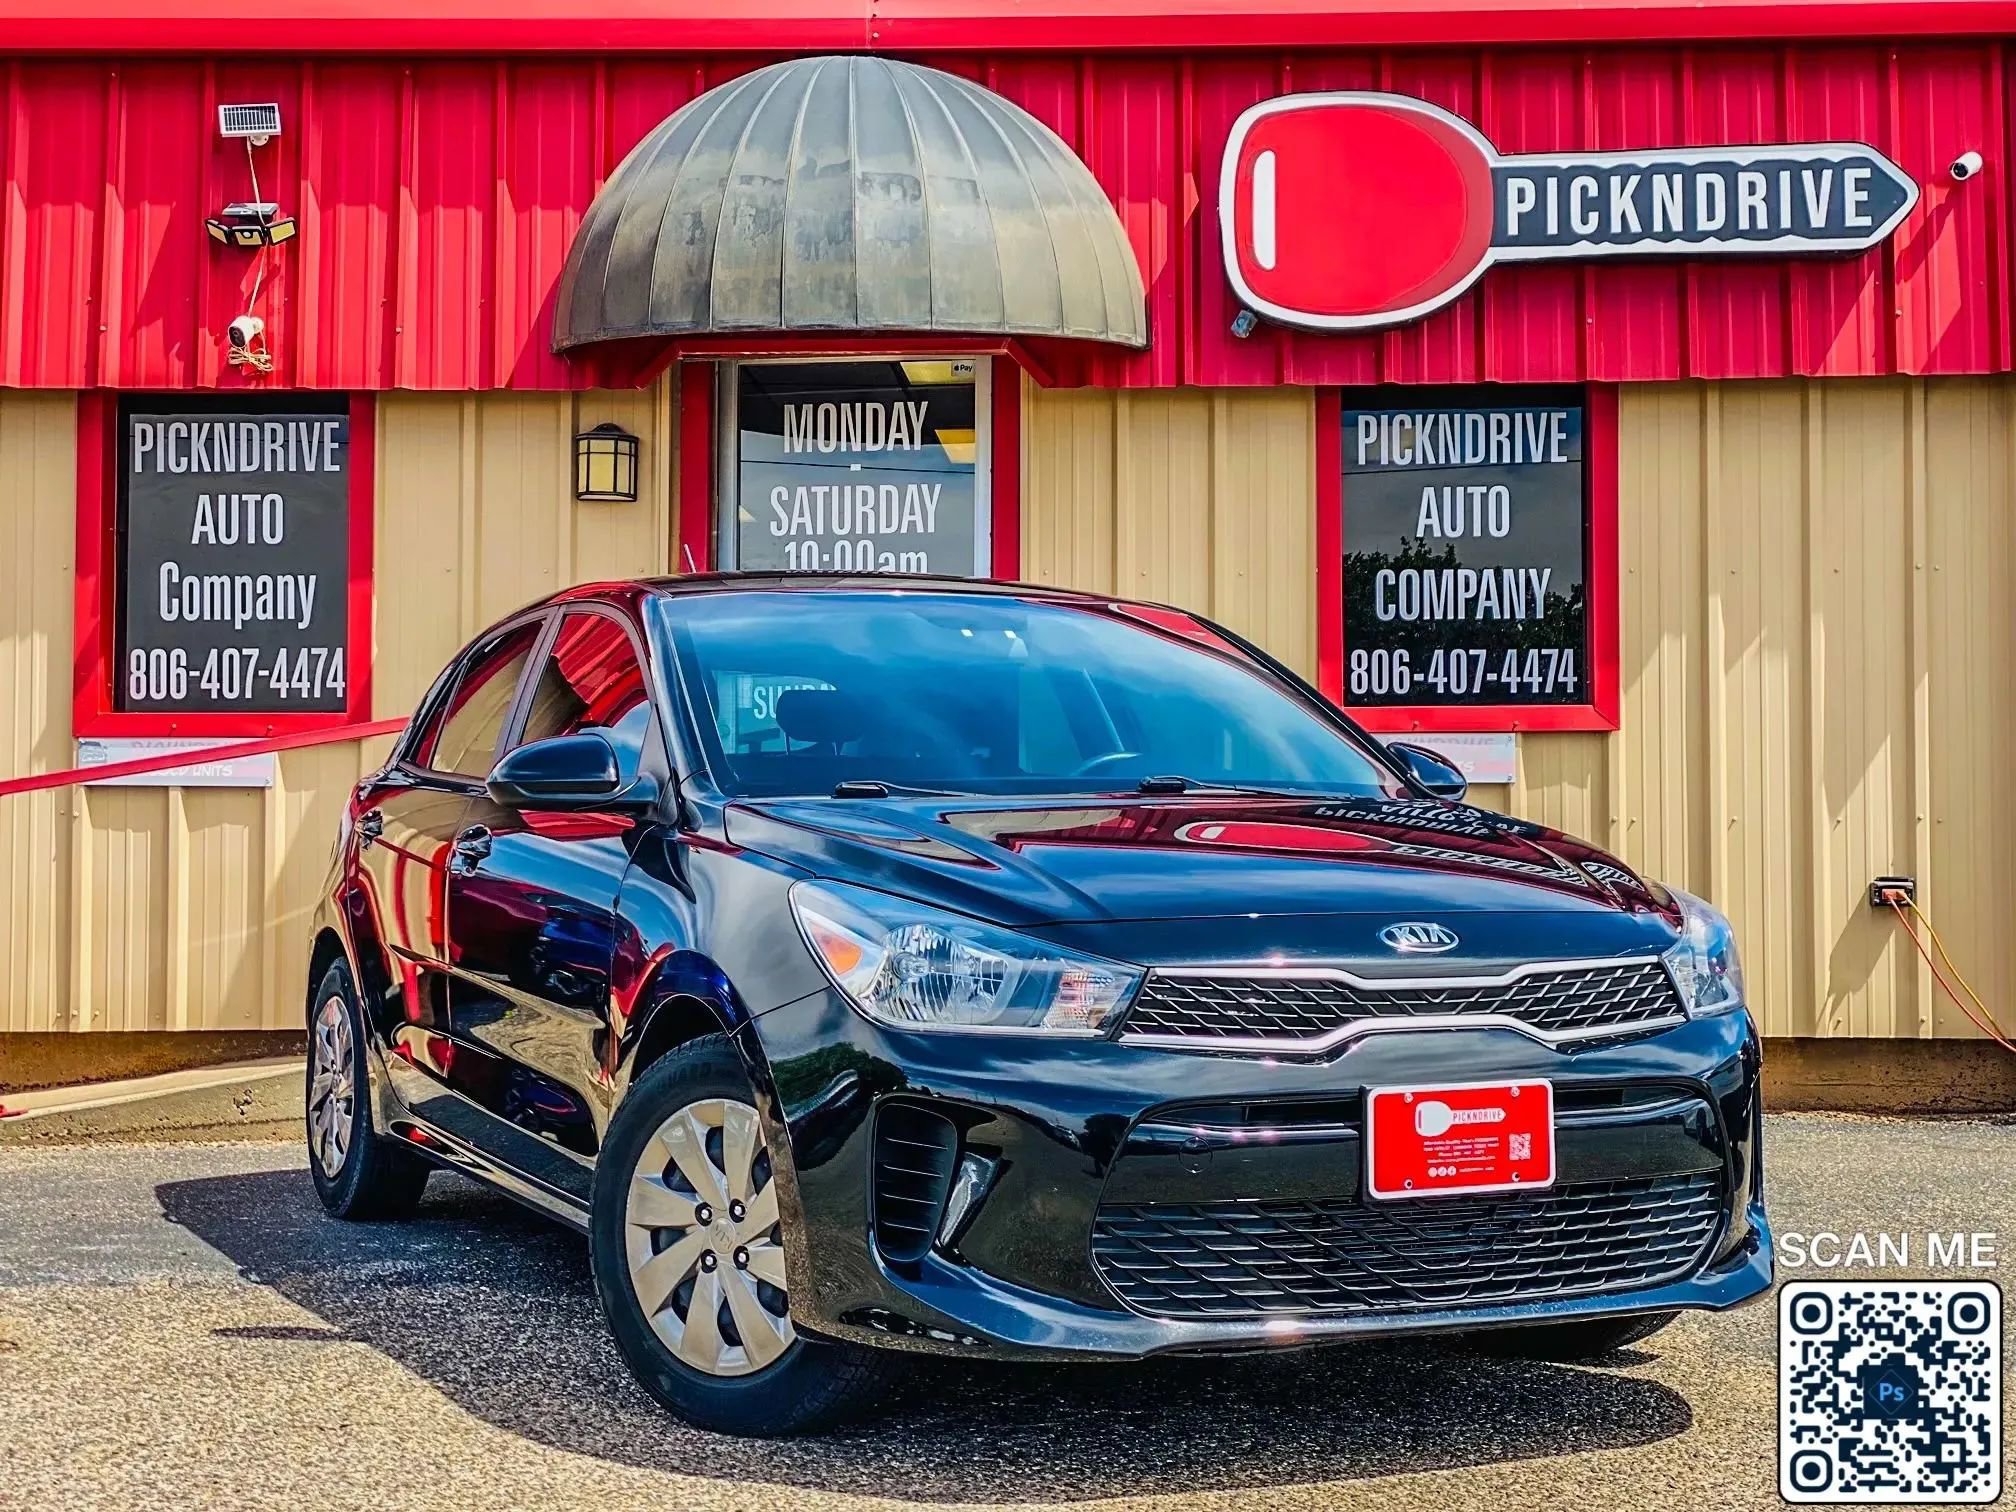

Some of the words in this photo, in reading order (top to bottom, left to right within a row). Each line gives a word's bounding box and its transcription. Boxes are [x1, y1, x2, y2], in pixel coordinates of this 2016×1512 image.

[1507, 166, 1875, 237] PICKNDRIVE
[960, 364, 973, 373] Pay
[134, 421, 341, 473] PICKNDRIVE
[783, 401, 929, 453] MONDAY
[1357, 411, 1568, 465] PICKNDRIVE
[191, 493, 285, 545] AUTO
[769, 483, 942, 537] SATURDAY
[1416, 485, 1510, 539] AUTO
[159, 561, 317, 631] Company
[1375, 567, 1552, 622] COMPANY
[129, 647, 347, 700] 806-407-4474
[1350, 648, 1578, 696] 806-407-4474
[1390, 925, 1452, 946] KIA
[1453, 1110, 1502, 1122] PICKNDRIVE
